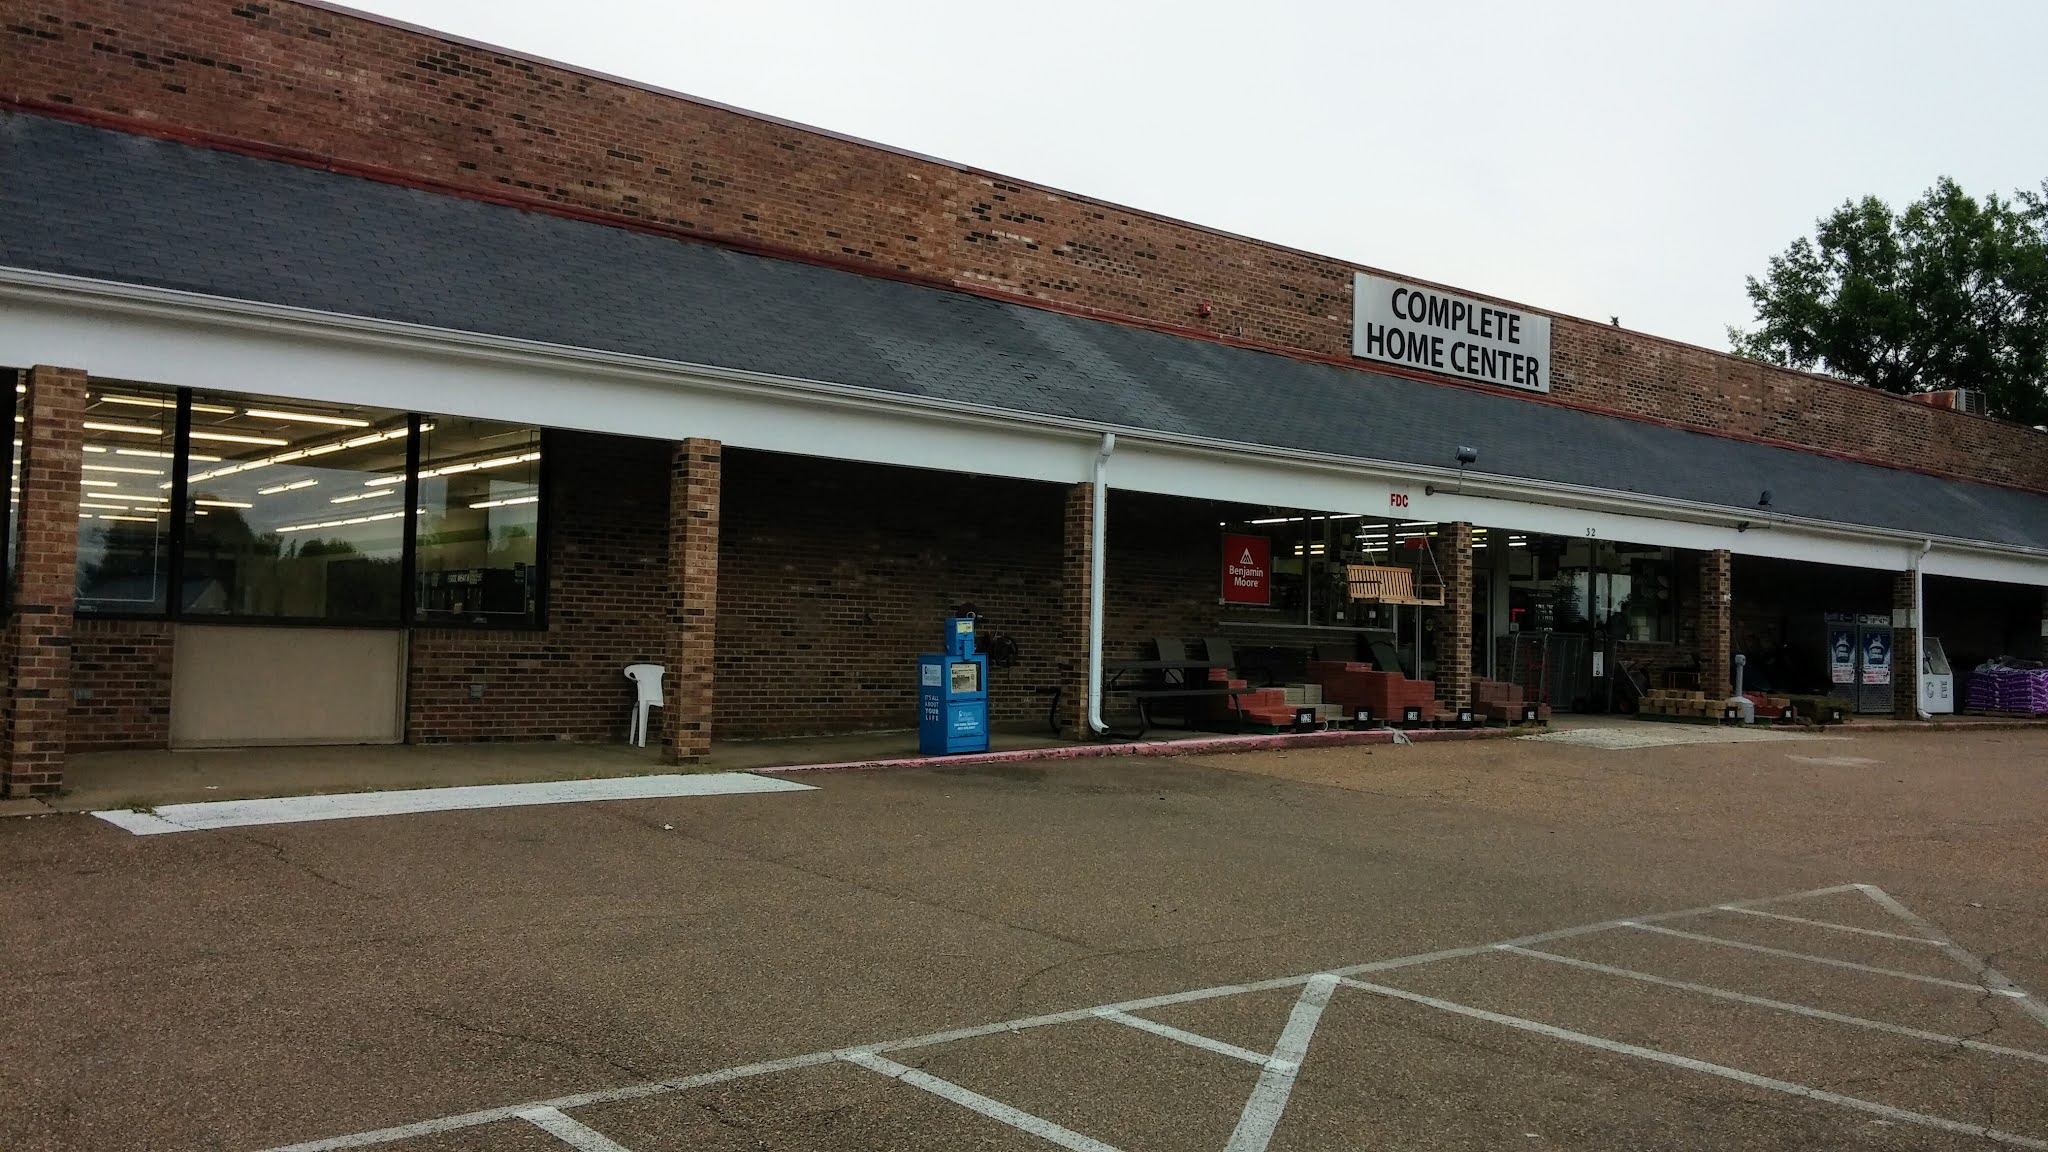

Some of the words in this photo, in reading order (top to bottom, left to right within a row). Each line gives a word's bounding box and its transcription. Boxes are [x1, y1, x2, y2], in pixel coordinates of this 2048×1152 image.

[1392, 288, 1521, 345] COMPLETE
[1367, 322, 1444, 369] HOME
[1450, 341, 1540, 387] CENTER
[1390, 493, 1409, 508] FDC
[1229, 565, 1264, 578] Benjamin
[1234, 577, 1259, 588] Moore
